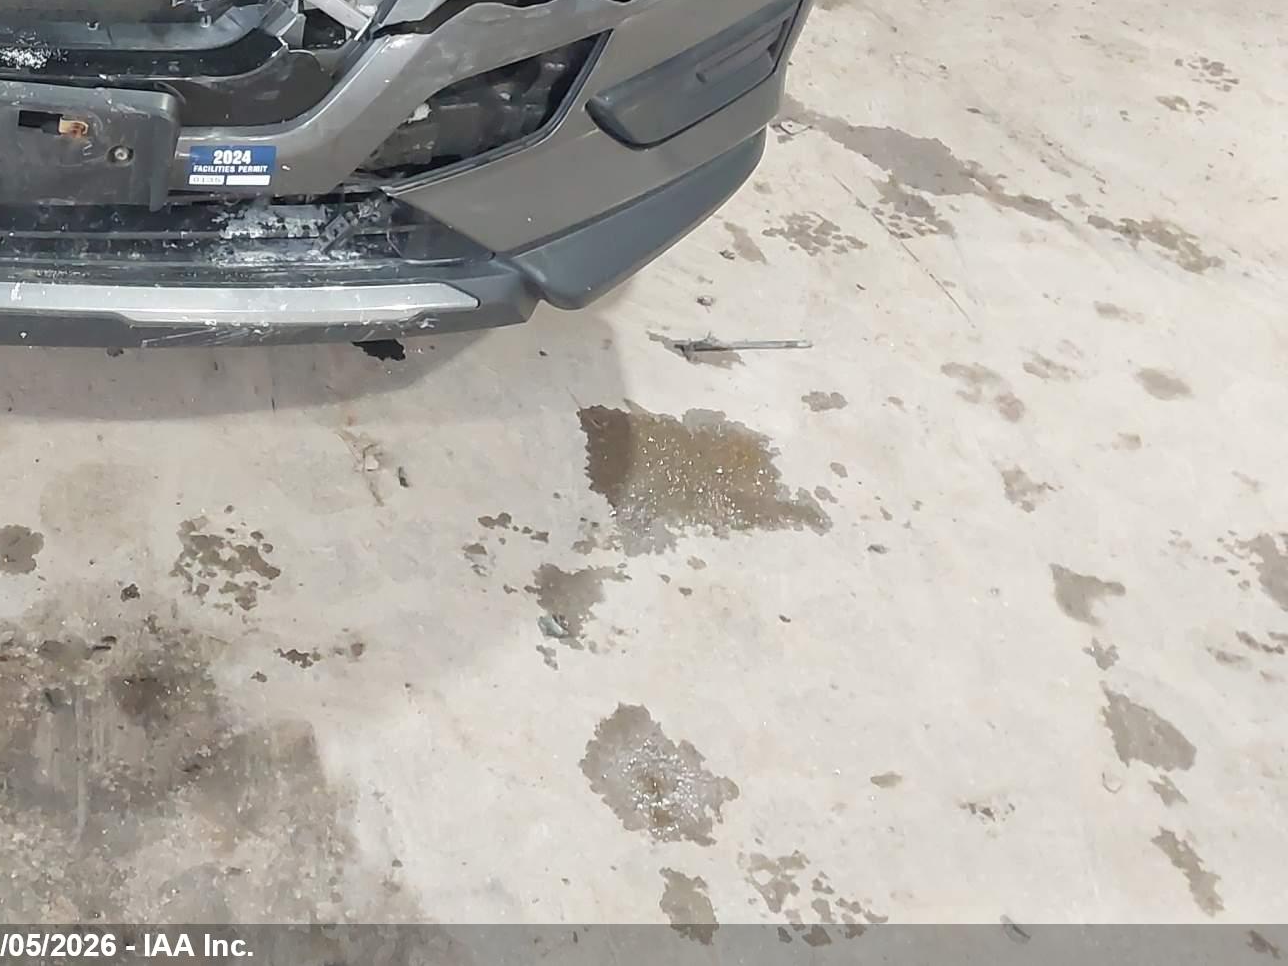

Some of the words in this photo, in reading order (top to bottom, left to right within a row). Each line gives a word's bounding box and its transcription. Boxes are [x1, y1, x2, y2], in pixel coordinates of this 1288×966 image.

[213, 150, 251, 165] 2024
[193, 165, 236, 173] FACILITIES
[238, 165, 268, 174] PERMIT
